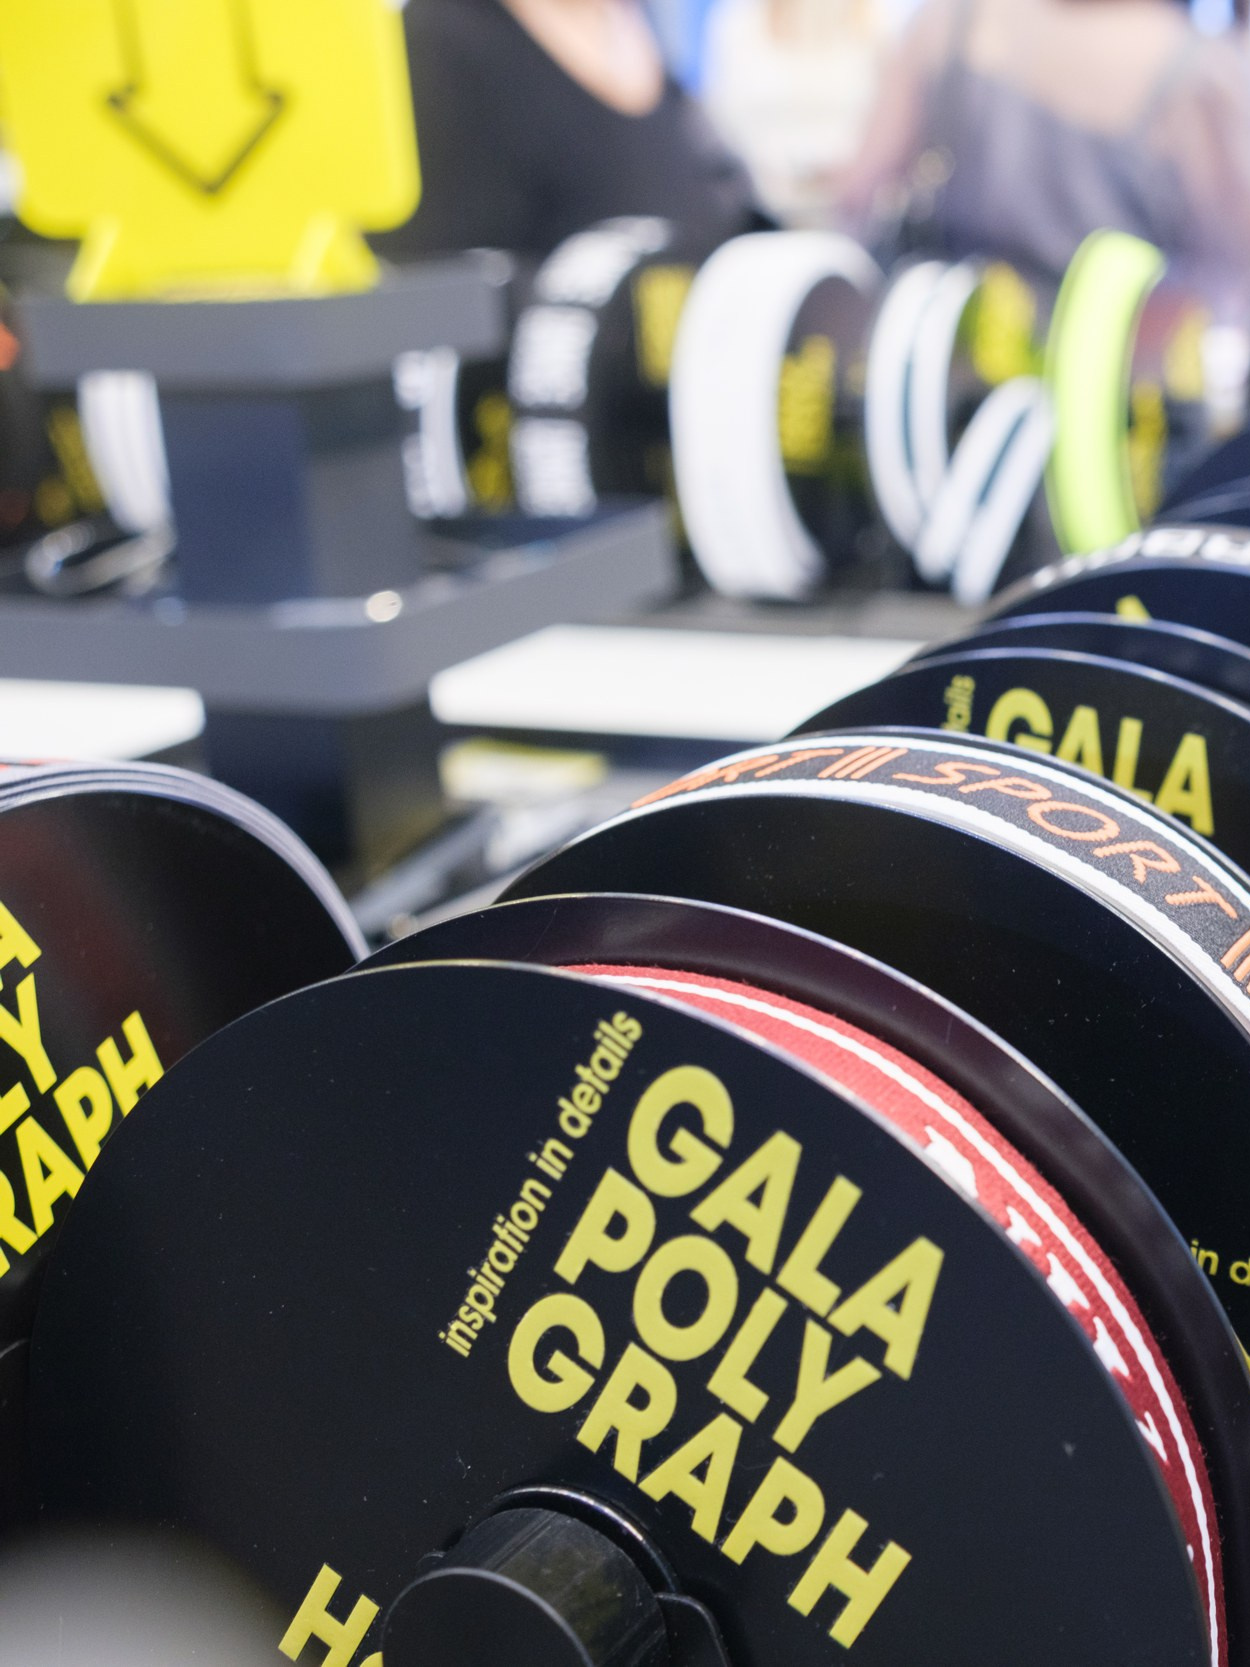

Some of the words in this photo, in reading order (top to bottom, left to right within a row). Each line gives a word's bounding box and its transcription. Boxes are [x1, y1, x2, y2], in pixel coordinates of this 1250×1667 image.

[893, 760, 1239, 919] SPORT
[438, 1177, 552, 1358] inspiration
[527, 1137, 575, 1182] in
[557, 1010, 643, 1139] details
[553, 1166, 882, 1454] POLY
[627, 1064, 945, 1381] GALA
[507, 1292, 913, 1650] GRAPH
